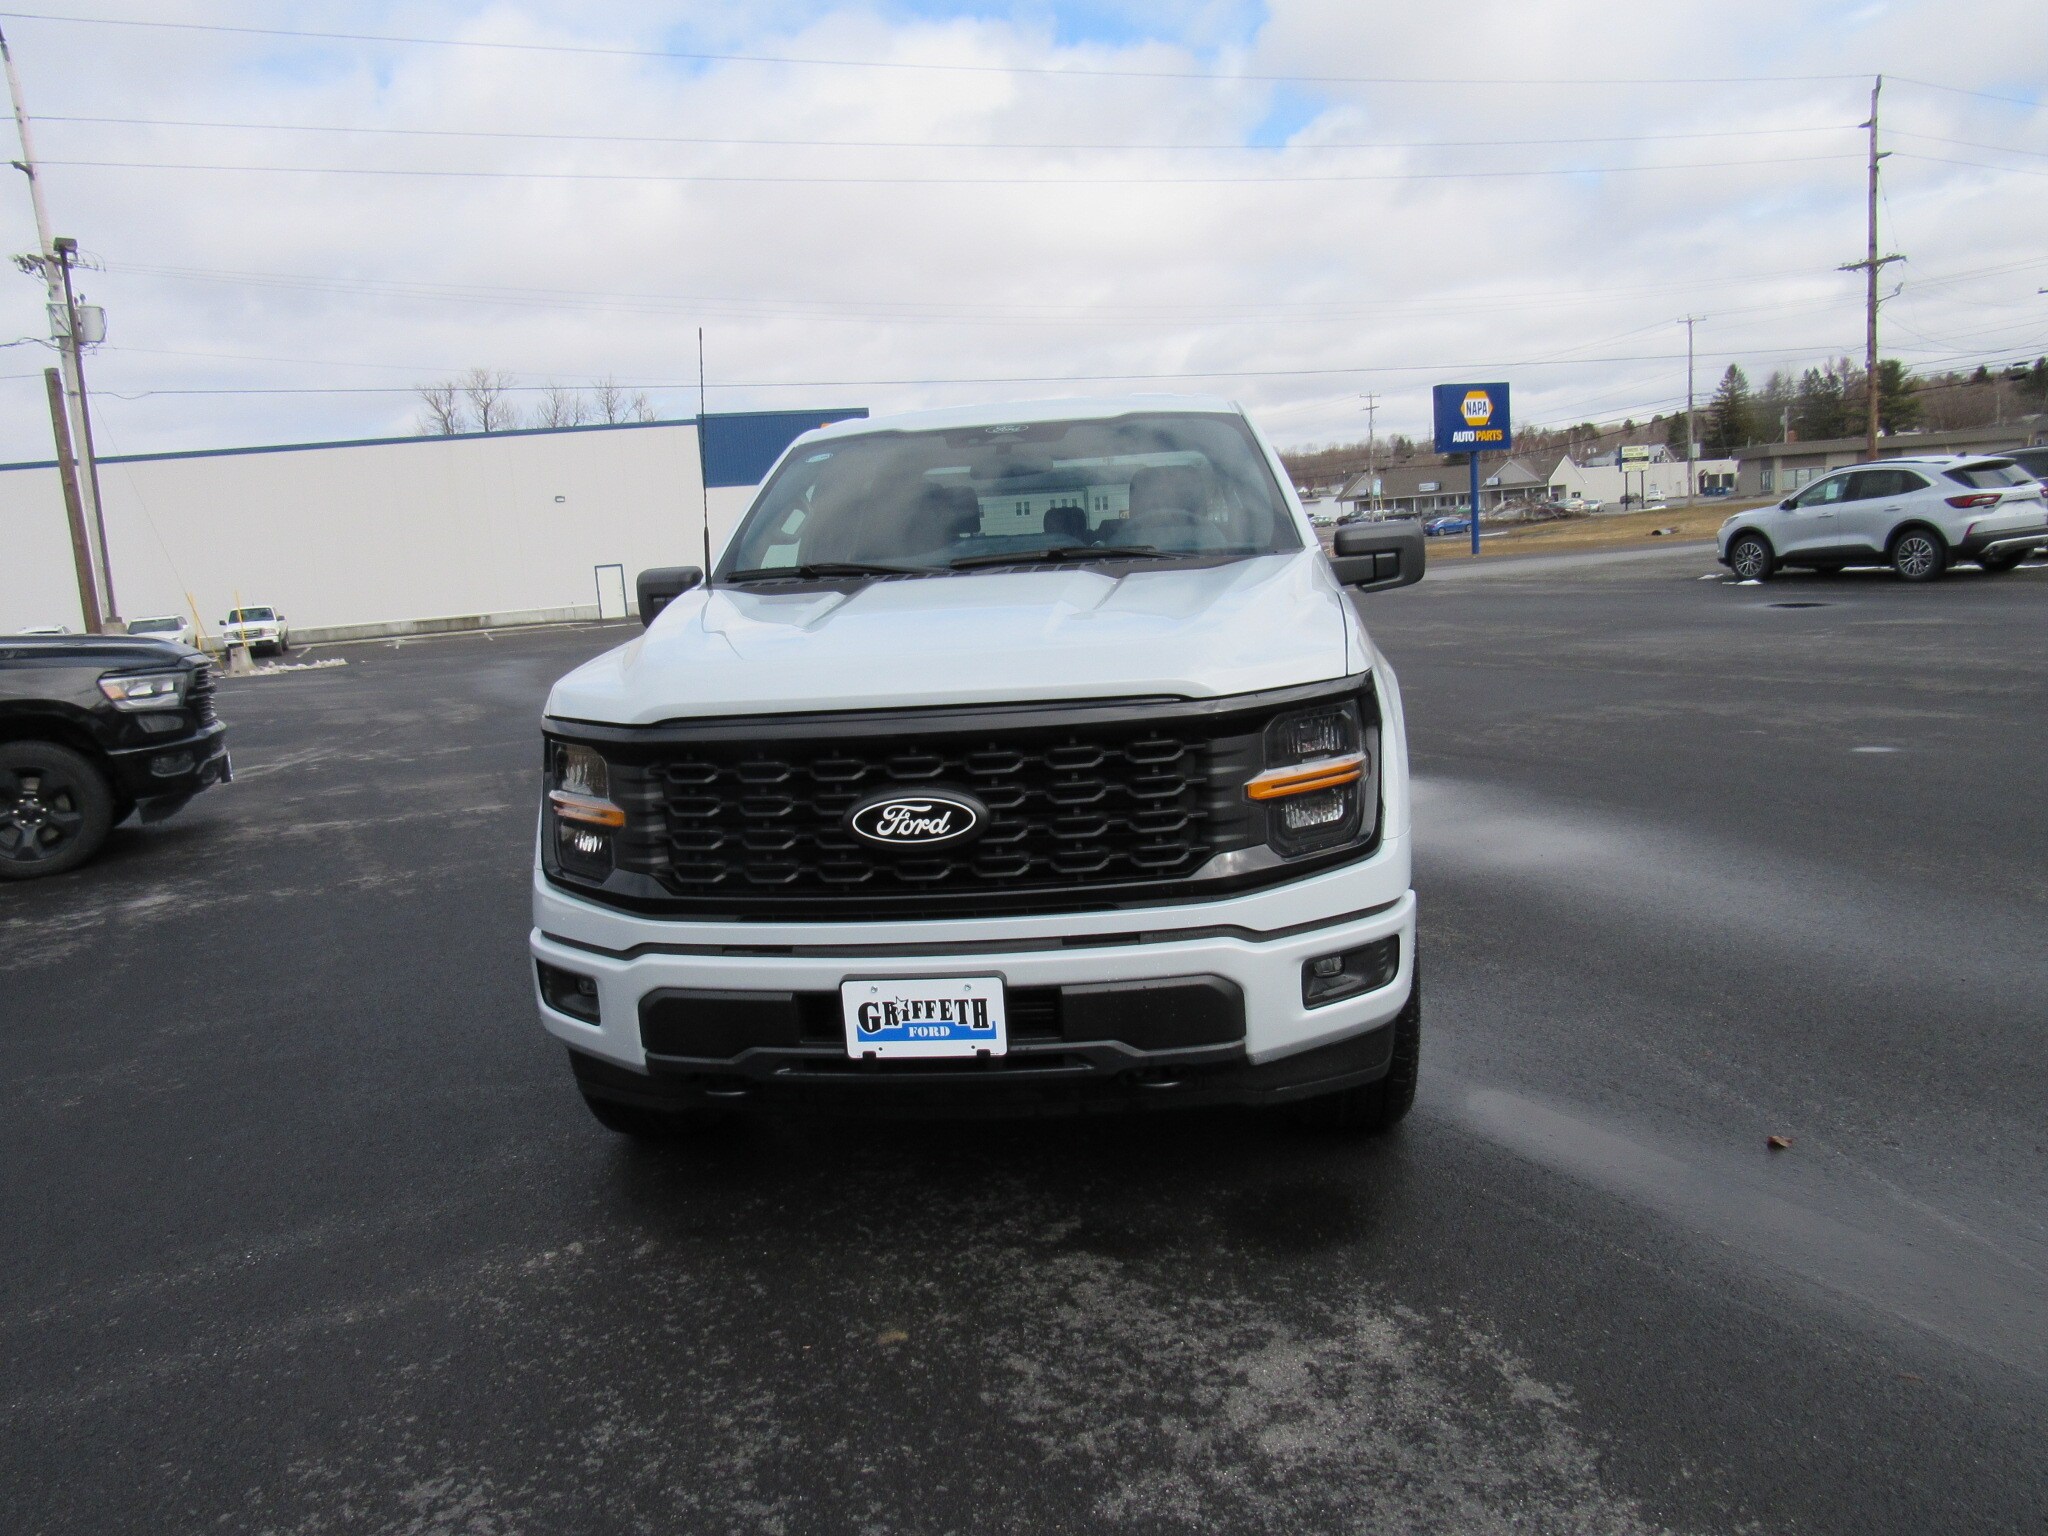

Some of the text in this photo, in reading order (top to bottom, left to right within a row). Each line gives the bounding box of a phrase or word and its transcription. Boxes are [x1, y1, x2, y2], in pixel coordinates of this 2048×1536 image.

[1466, 401, 1487, 416] NAPA
[1453, 430, 1503, 442] AUTO PARTS
[876, 804, 951, 836] Ford
[908, 1026, 951, 1038] FORD
